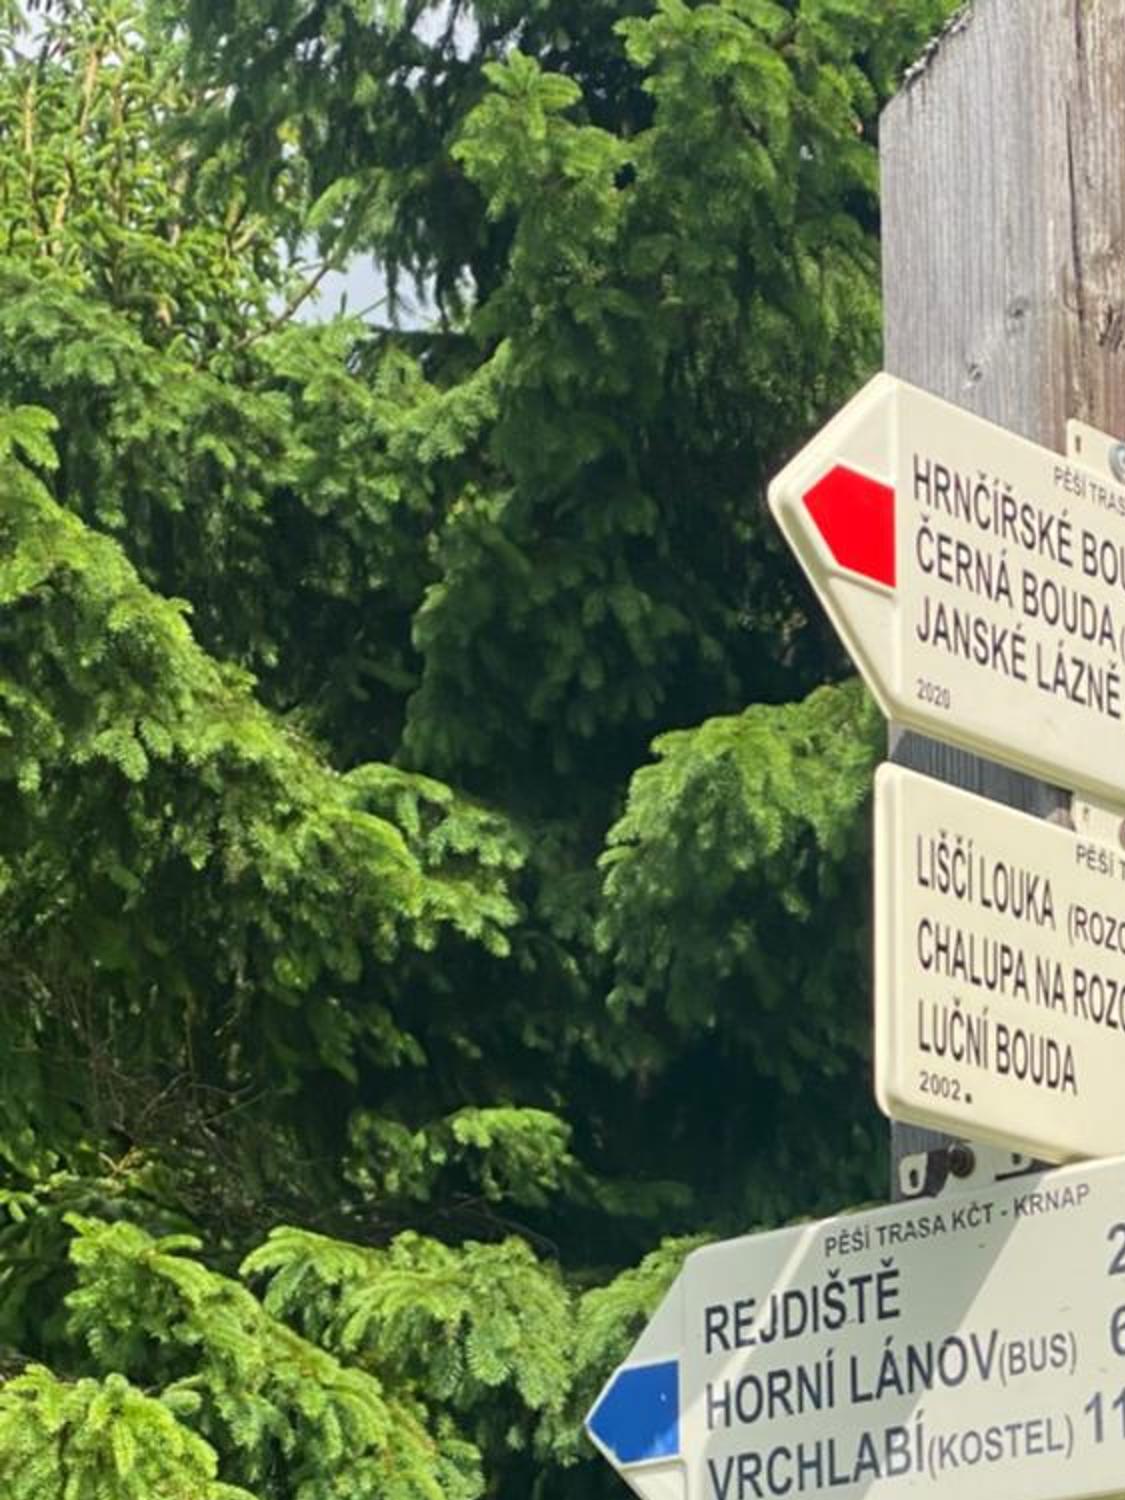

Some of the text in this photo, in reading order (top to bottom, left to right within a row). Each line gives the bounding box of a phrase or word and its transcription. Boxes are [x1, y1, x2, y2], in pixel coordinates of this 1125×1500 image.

[913, 453, 1073, 568] HRNČÍŘSKÉ
[916, 514, 1013, 609] ČERNÁ
[1022, 569, 1117, 652] BOUDA
[916, 595, 1028, 682] JANSKÉ
[1036, 640, 1121, 720] LÁZNĚ
[917, 677, 951, 710] 2020
[917, 828, 973, 903] LIŠČÍ
[980, 854, 1056, 931] LOUKA
[917, 917, 1030, 1003] CHALUPA
[1036, 954, 1067, 1015] NA
[918, 997, 989, 1070] LUČNÍ
[996, 1022, 1078, 1097] BOUDA
[877, 1215, 946, 1245] TRASA
[951, 1201, 993, 1230] KČT
[1013, 1183, 1090, 1217] KRNAP
[705, 1256, 900, 1354] REJDIŠTĚ
[706, 1348, 834, 1430] HORNÍ
